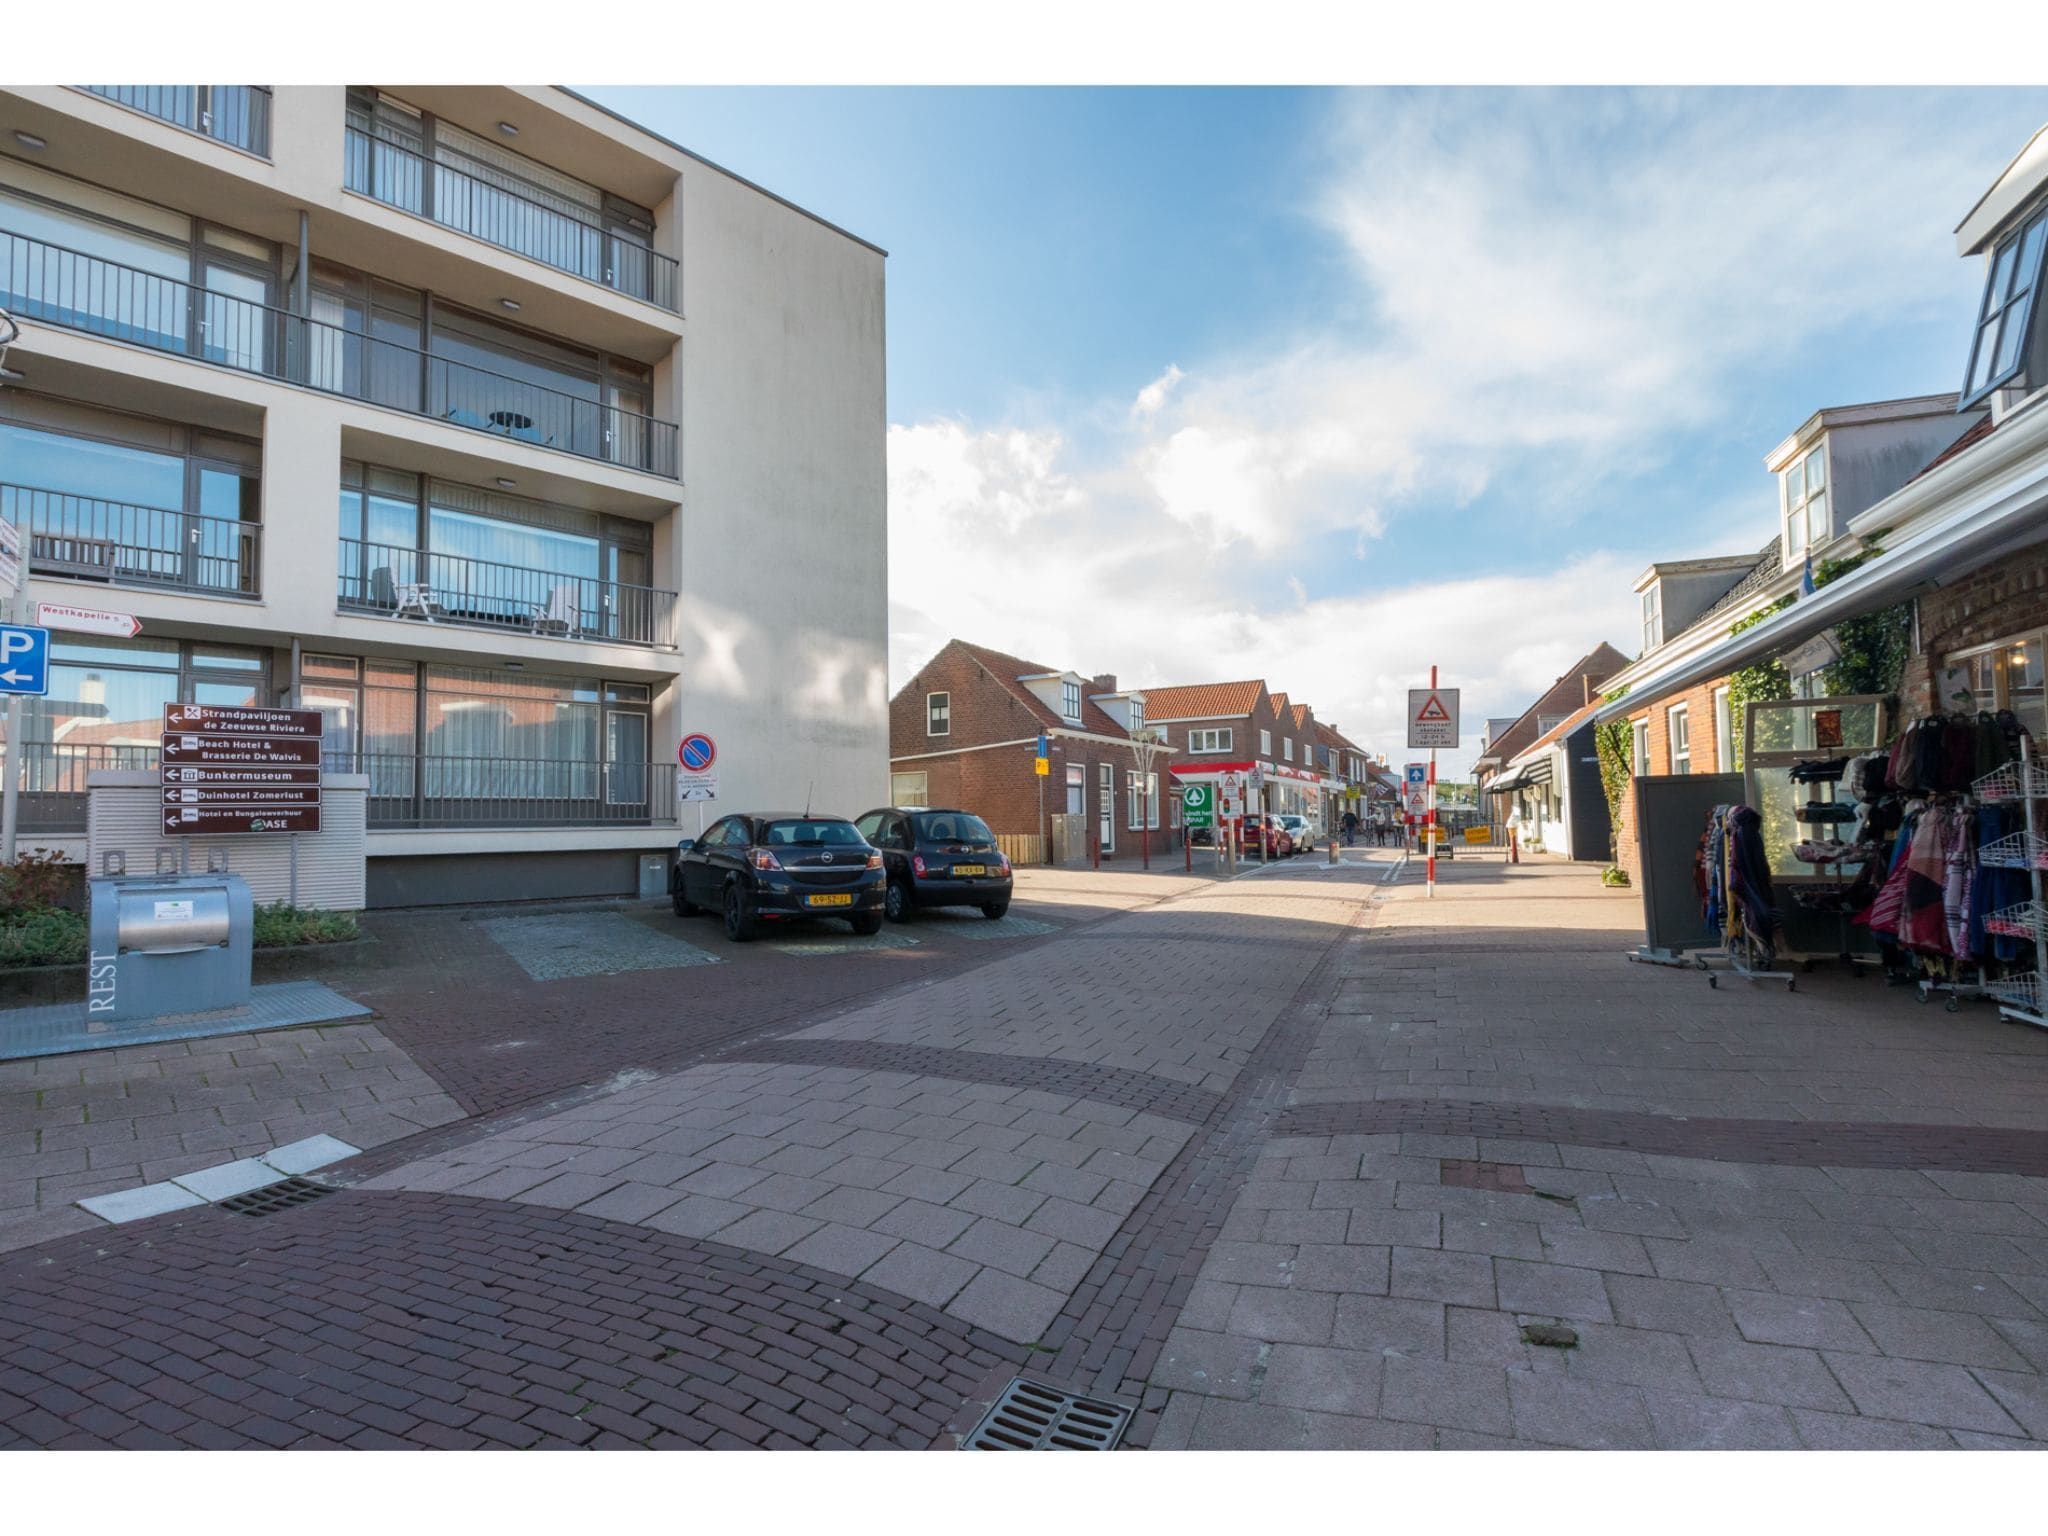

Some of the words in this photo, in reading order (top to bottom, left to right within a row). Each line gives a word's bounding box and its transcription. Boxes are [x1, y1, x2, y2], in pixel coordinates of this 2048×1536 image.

[42, 605, 111, 620] Westkapelle
[1, 631, 34, 664] P
[202, 709, 291, 722] Strandpaviljoen
[204, 721, 216, 730] de
[220, 722, 267, 731] Zeeuwse
[269, 723, 305, 733] Riviera
[199, 740, 230, 749] Beach
[233, 740, 261, 749] Hotel
[264, 741, 272, 749] &
[202, 751, 251, 760] Brasserie
[254, 752, 267, 760] De
[269, 752, 302, 761] Walvis
[199, 771, 292, 780] Bunkermuseum
[199, 791, 250, 800] Duinhotel
[253, 791, 304, 800] Zomerlust
[235, 810, 303, 818] Bungalowverhuur
[88, 950, 117, 1013] REST
